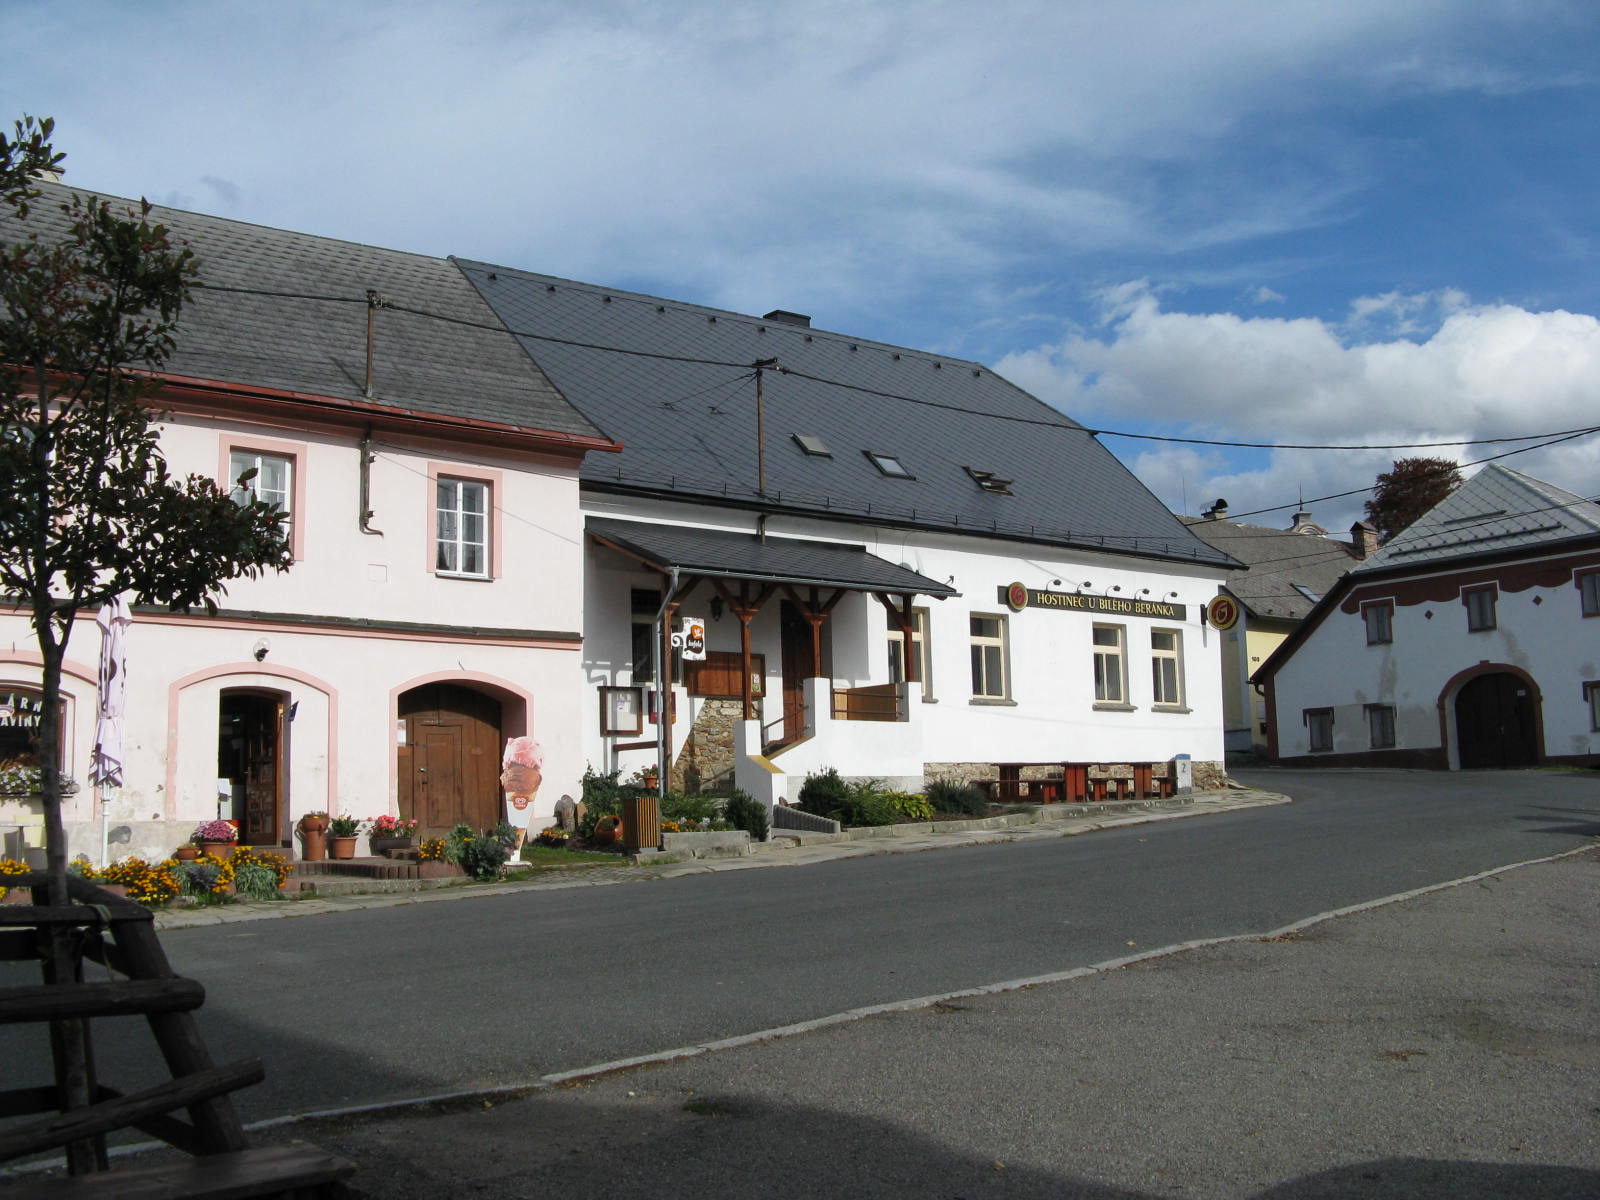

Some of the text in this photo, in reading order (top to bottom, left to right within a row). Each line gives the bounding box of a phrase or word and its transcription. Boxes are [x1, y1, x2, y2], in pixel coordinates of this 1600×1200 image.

[1037, 593, 1084, 608] HOSTINEC
[1088, 597, 1096, 609] U
[1135, 602, 1175, 616] BERÁNKA
